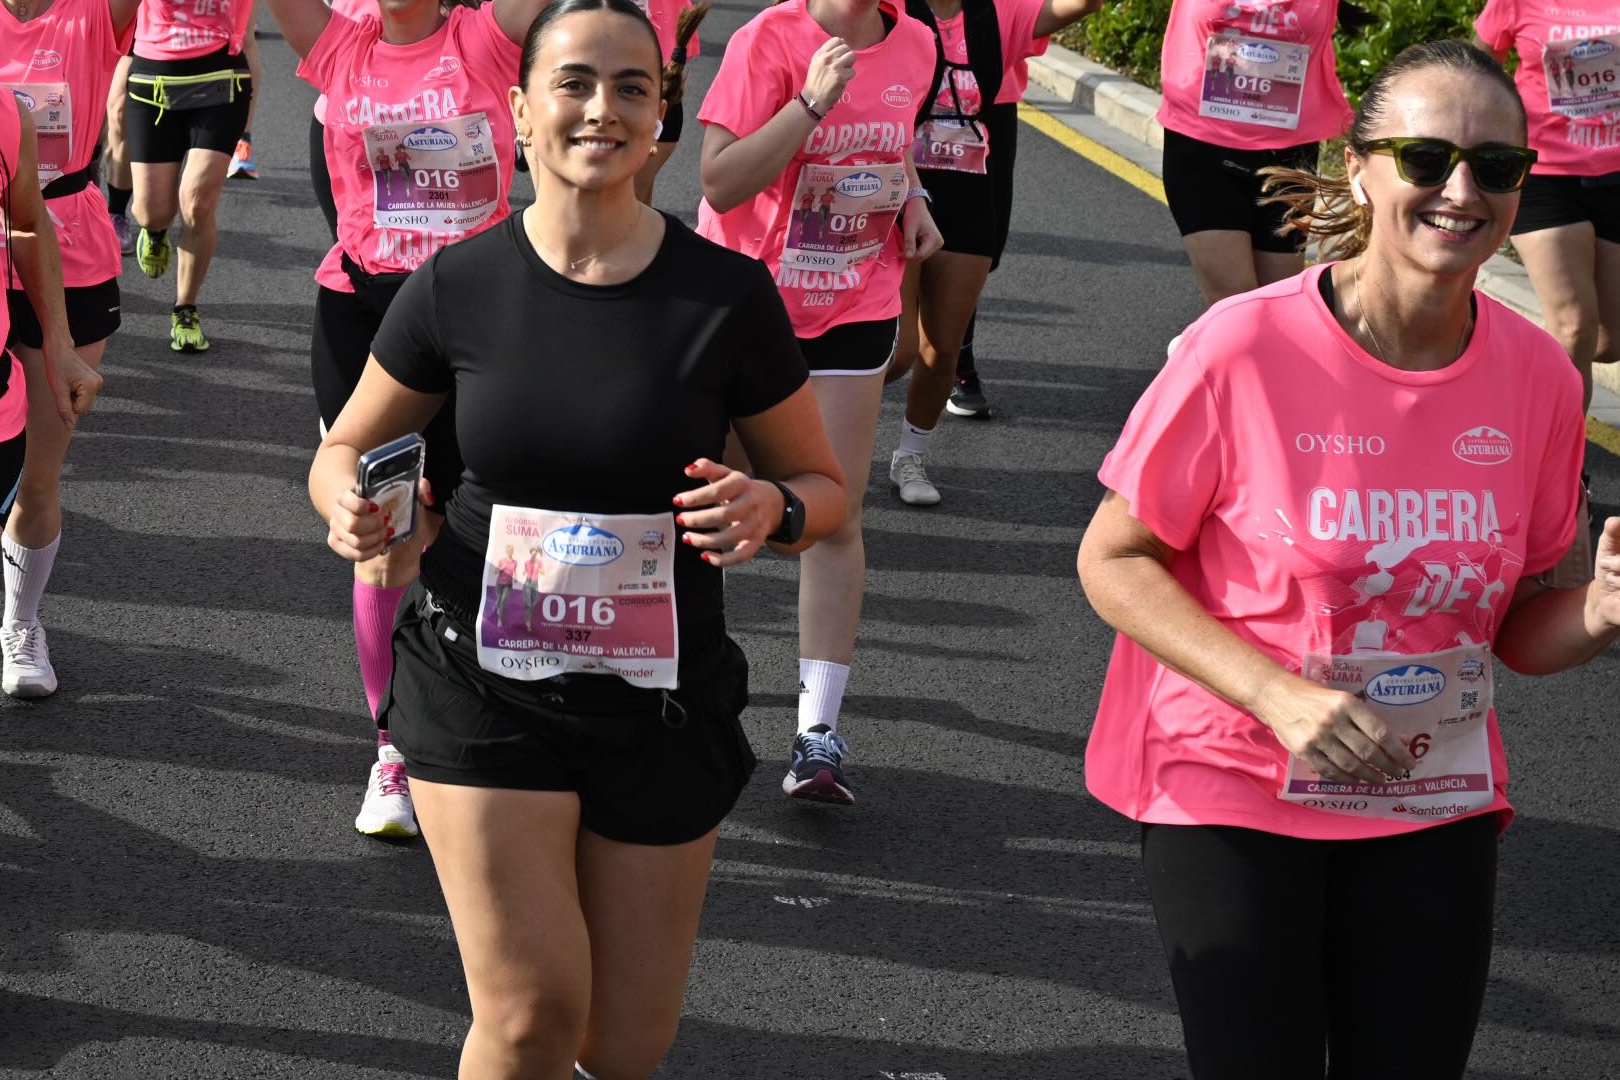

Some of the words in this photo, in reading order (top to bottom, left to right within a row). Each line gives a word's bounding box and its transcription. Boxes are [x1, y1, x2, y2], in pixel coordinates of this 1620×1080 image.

[1234, 75, 1272, 93] 016
[1578, 69, 1616, 87] 016
[1209, 106, 1240, 116] OYSHO
[407, 137, 454, 146] ASTURIANA
[803, 120, 907, 155] CARRERA
[931, 141, 965, 157] 016
[414, 170, 460, 188] 016
[839, 181, 879, 192] ASTURIANA
[428, 191, 449, 200] 2301
[387, 202, 415, 210] CARRERA
[426, 201, 435, 209] LA
[436, 201, 456, 209] MUJER
[388, 215, 429, 225] OYSHO
[830, 213, 868, 232] 016
[798, 242, 825, 251] CARRERA
[796, 254, 836, 266] OYSHO
[802, 292, 834, 307] 2026
[1295, 433, 1385, 456] OYSHO
[1459, 440, 1510, 456] ASTURIANA
[1309, 486, 1503, 543] CARRERA
[506, 525, 540, 537] SUMA
[548, 537, 618, 556] ASTURIANA
[1402, 560, 1485, 617] DE
[542, 594, 616, 625] 016
[565, 629, 592, 642] 337
[498, 638, 540, 649] CARRERA
[543, 641, 554, 650] DE
[557, 643, 569, 652] LA
[571, 645, 604, 656] MUJER
[612, 647, 656, 657] VALENCIA
[501, 656, 560, 670] OYSHO
[598, 661, 655, 678] Santander
[1323, 671, 1363, 683] SUMA
[1371, 681, 1441, 697] ASTURIANA
[1308, 783, 1352, 794] CARRERA
[1356, 785, 1369, 793] DE
[1372, 786, 1384, 795] LA
[1386, 784, 1416, 795] MUJER
[1424, 778, 1468, 791] VALENCIA
[1302, 799, 1368, 811] OYSHO
[1409, 803, 1469, 816] Santander
